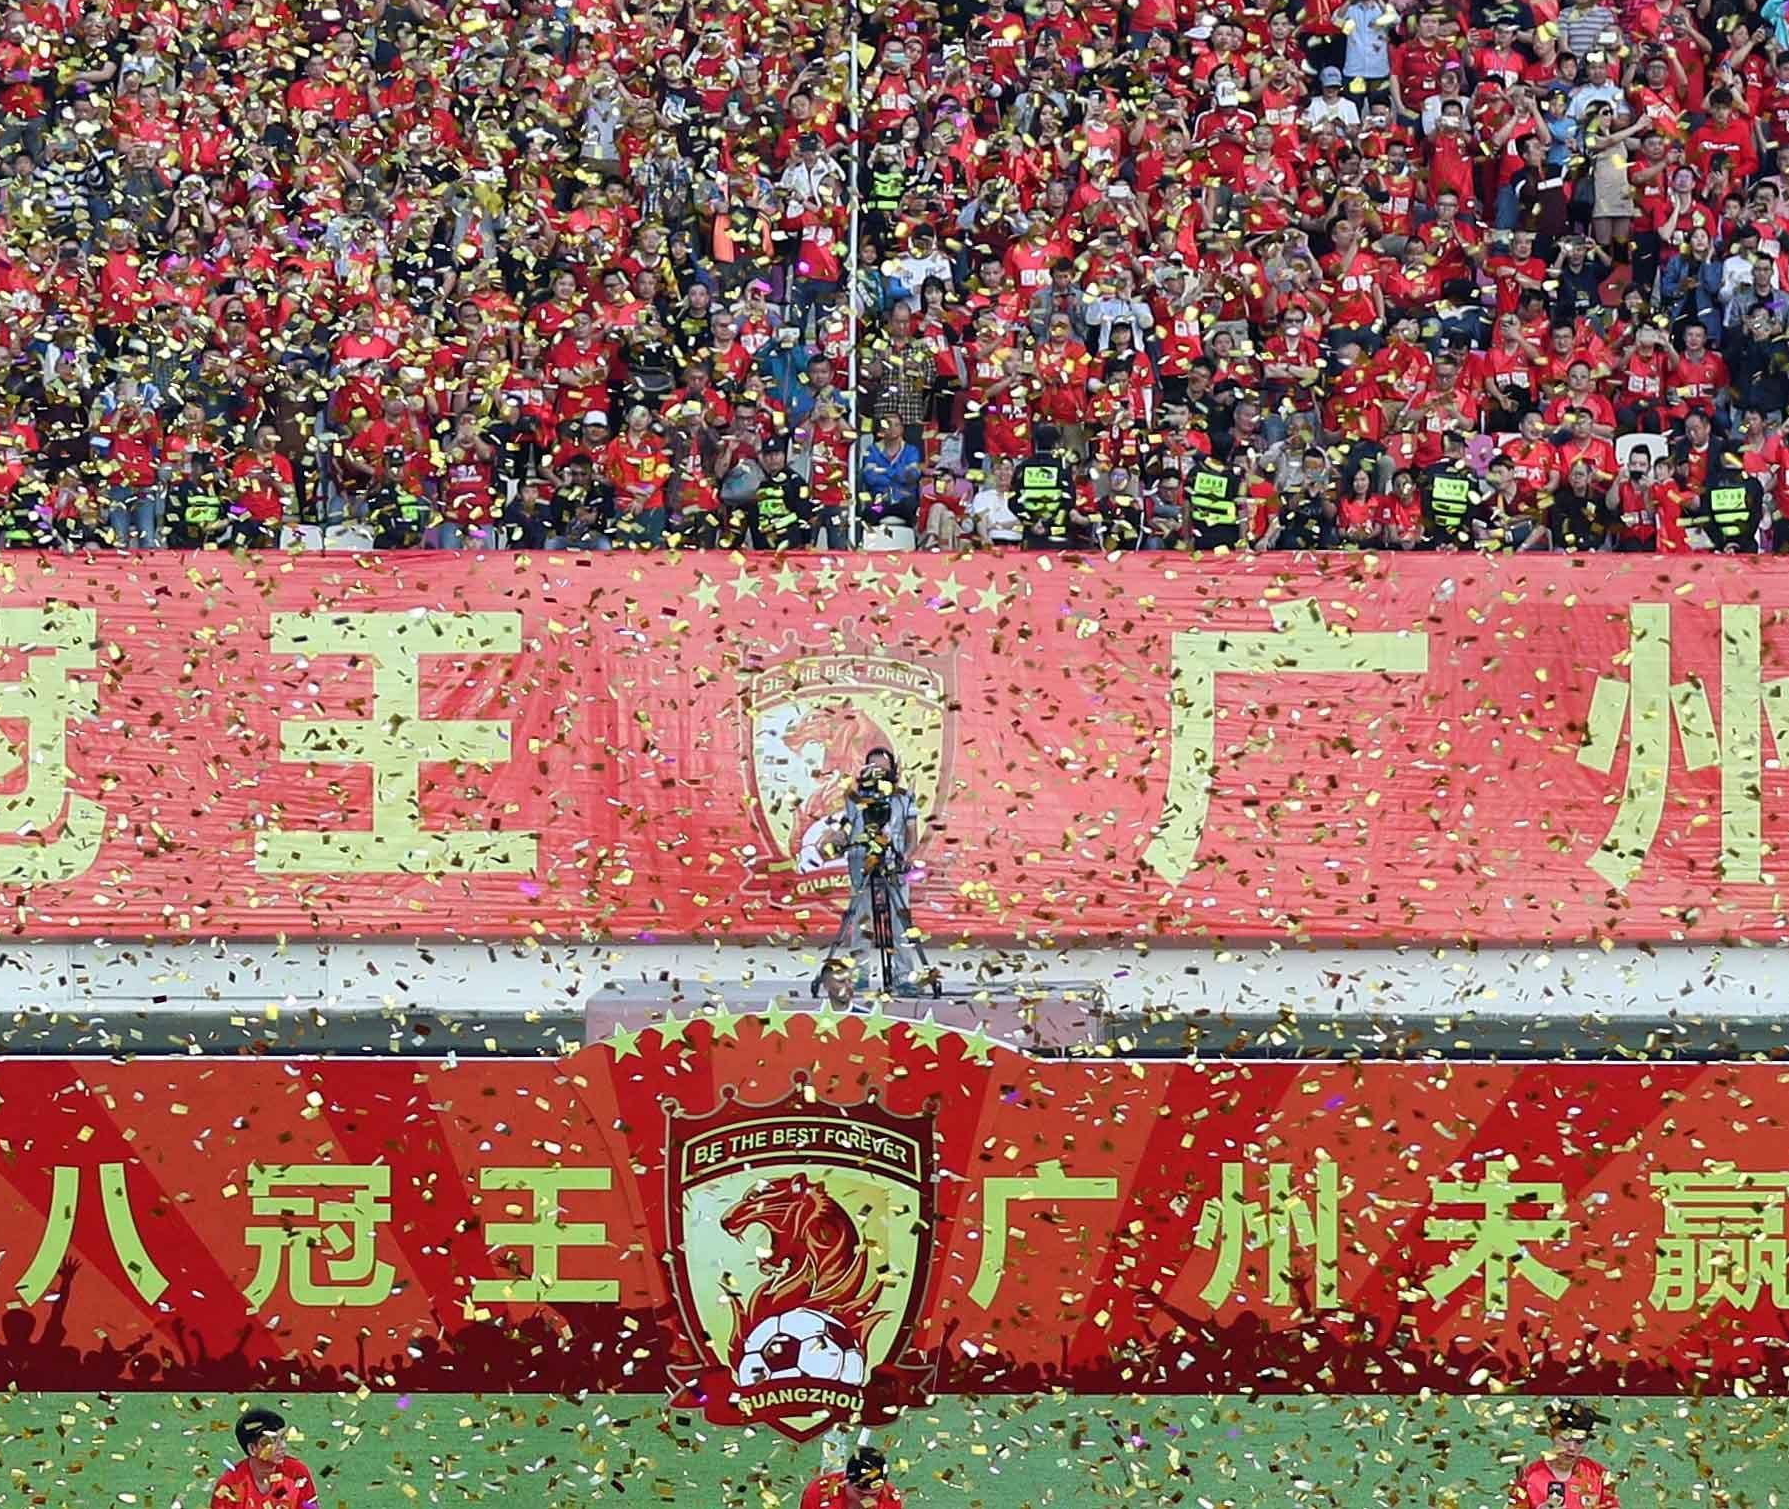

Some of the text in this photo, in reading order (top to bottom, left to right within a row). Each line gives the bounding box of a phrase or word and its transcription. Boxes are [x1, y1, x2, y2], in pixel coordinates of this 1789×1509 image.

[694, 1127, 908, 1164] BE THE BEST FOREVER
[738, 1388, 865, 1412] GUANGZHOU
